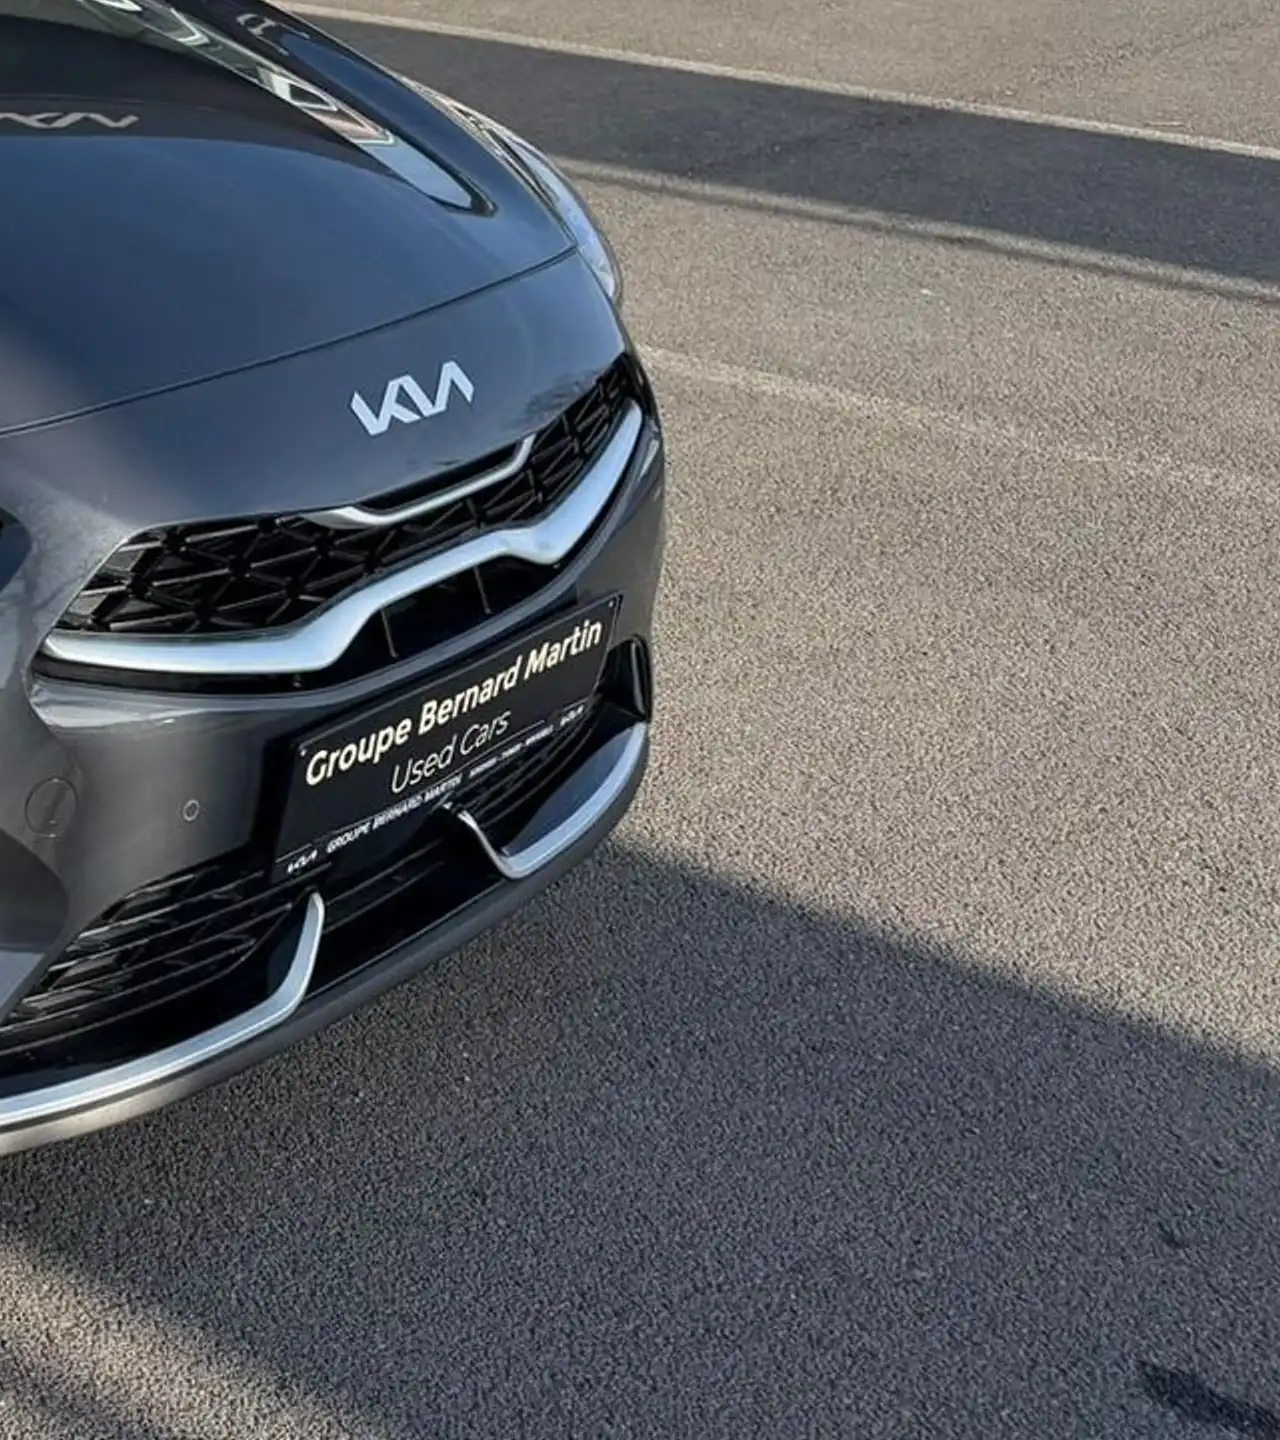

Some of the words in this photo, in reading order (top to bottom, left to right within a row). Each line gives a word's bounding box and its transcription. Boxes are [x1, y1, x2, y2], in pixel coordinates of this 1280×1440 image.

[350, 360, 475, 436] KIA
[305, 716, 412, 787] Groupe
[417, 654, 523, 737] Bernard
[523, 619, 603, 681] Martin
[391, 733, 458, 795] Used
[459, 710, 512, 756] Cars
[325, 819, 372, 855] GROUPE
[371, 793, 424, 832] BERNARD
[423, 773, 463, 803] MARTIN
